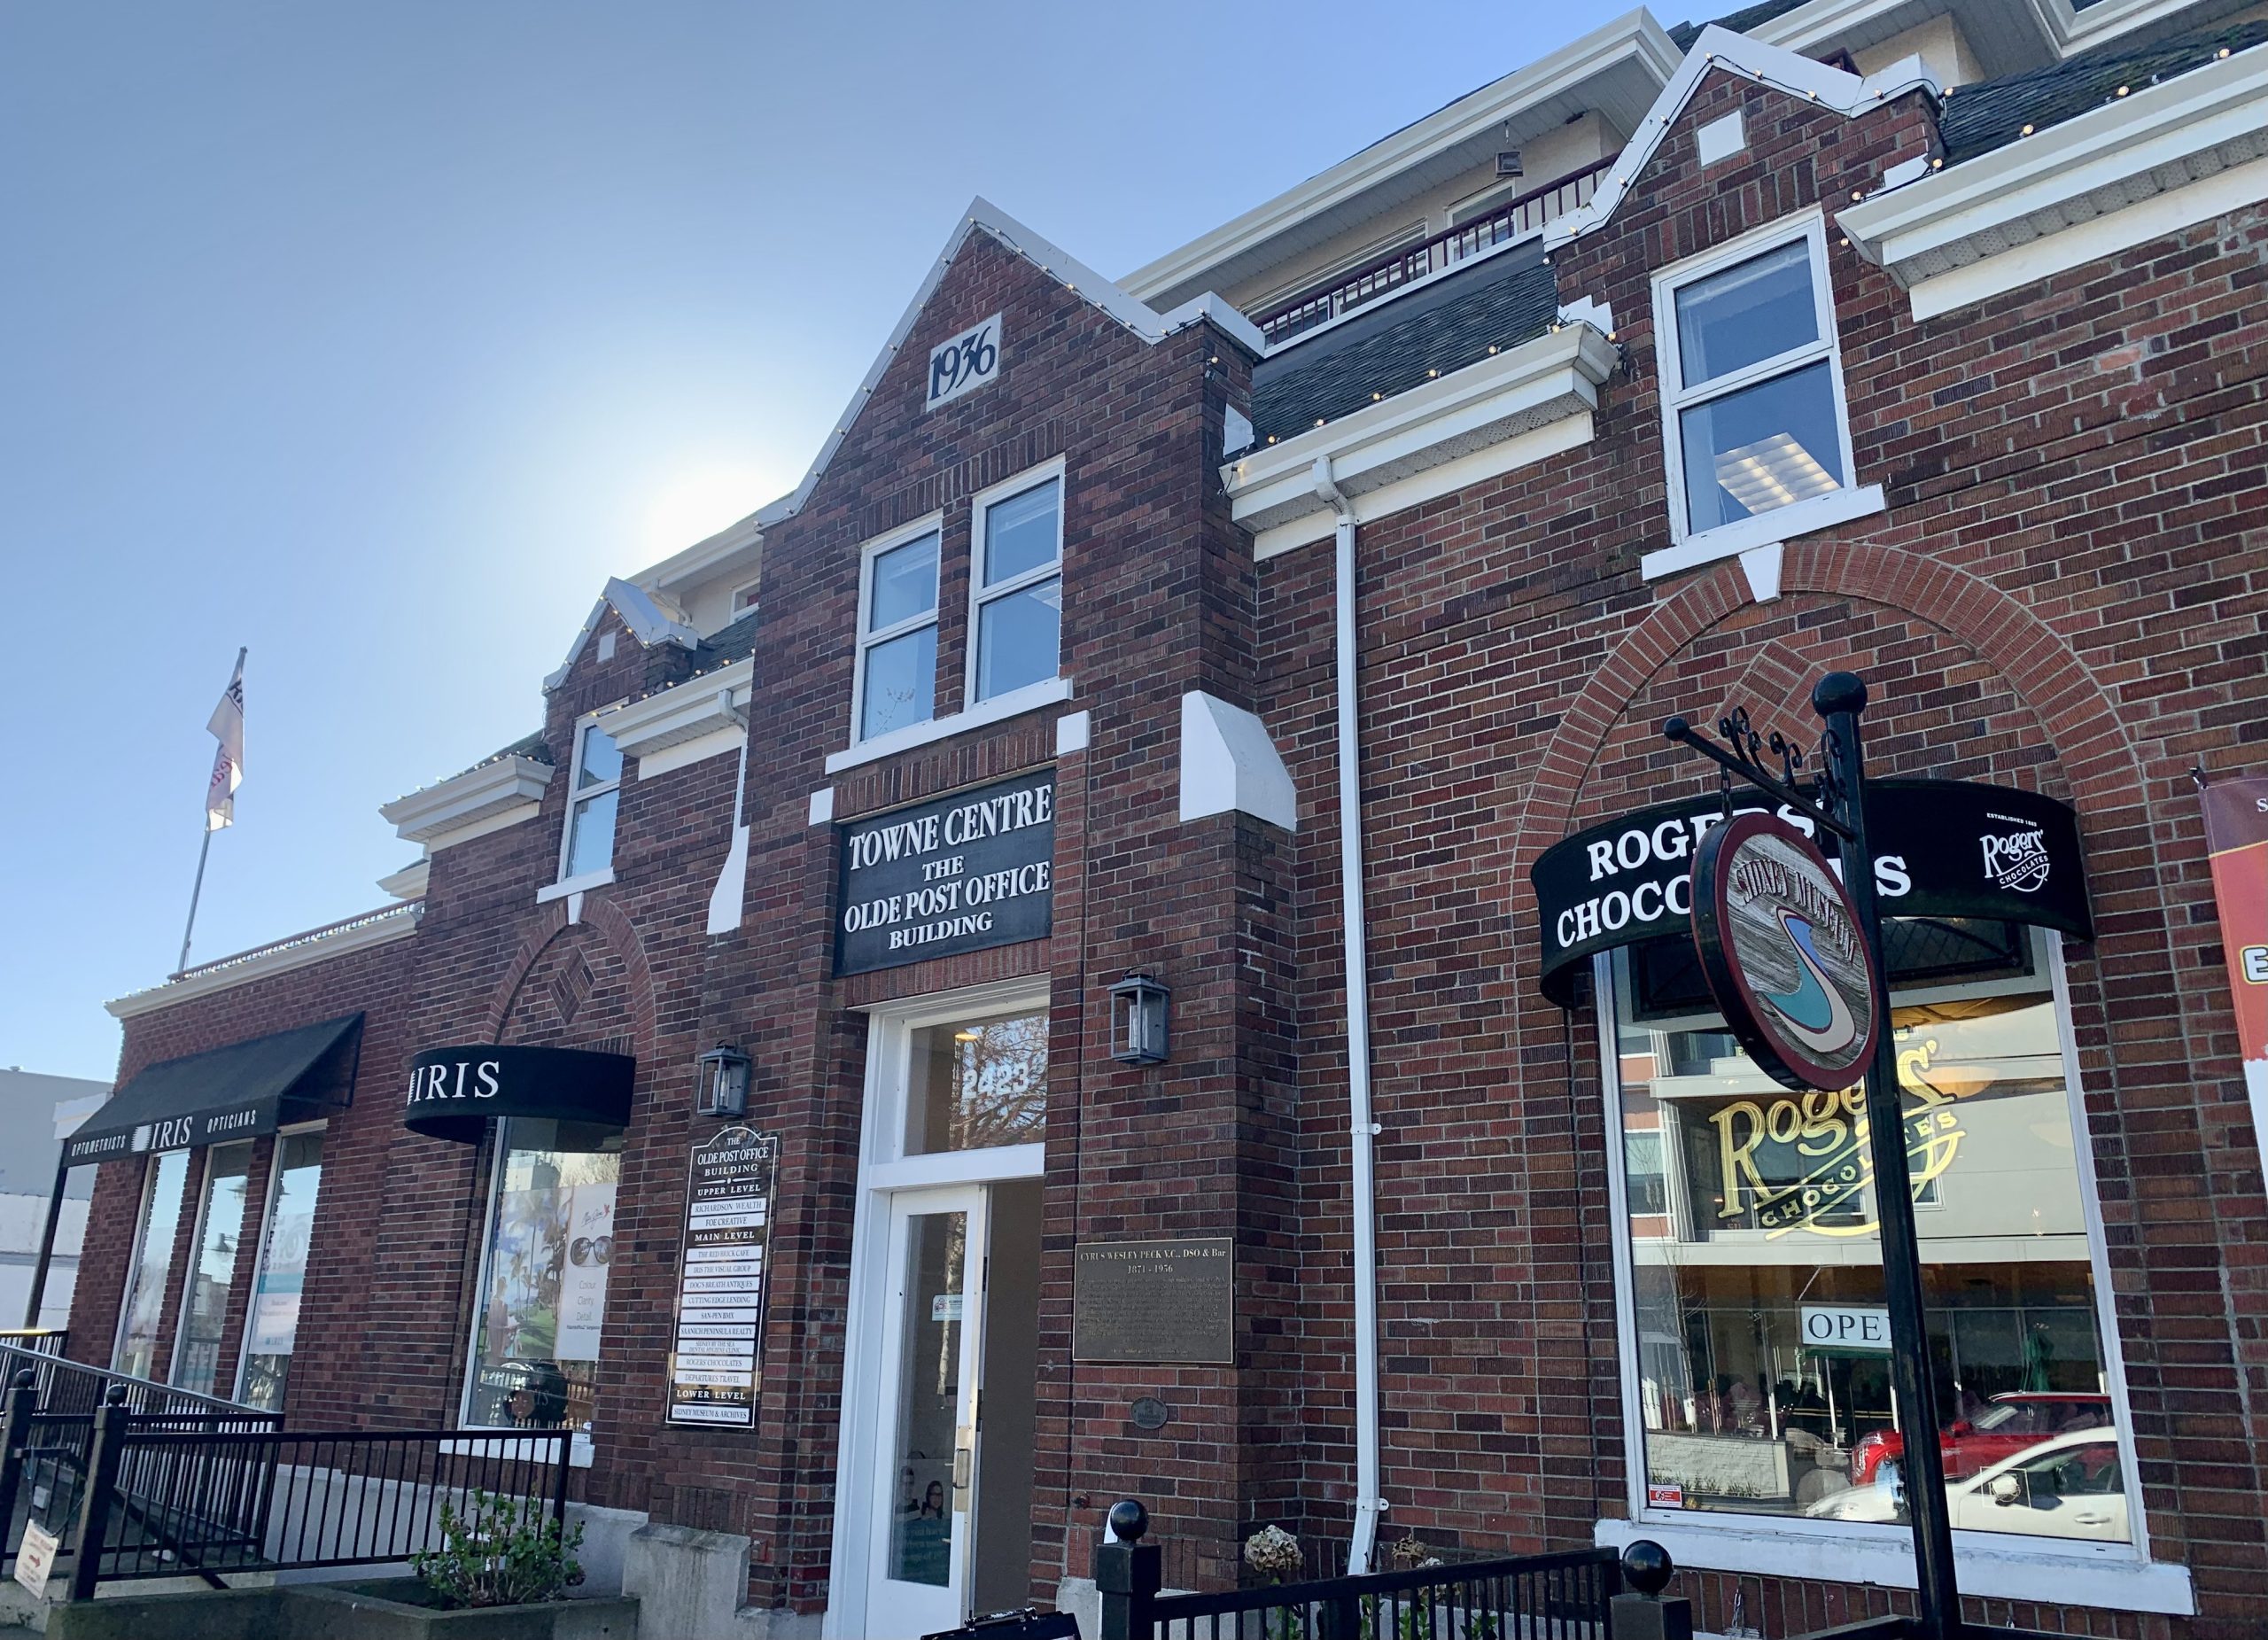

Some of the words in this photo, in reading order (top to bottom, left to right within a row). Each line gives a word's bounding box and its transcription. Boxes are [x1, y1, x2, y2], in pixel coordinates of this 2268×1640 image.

[928, 325, 996, 400] 1936
[850, 814, 940, 870] TOWNE
[944, 784, 1052, 846] CENTRE
[1986, 812, 2023, 824] ESTABLISHED
[922, 856, 964, 882] THE
[1999, 855, 2048, 884] CHOCOLATES
[844, 890, 902, 933] OLDE
[905, 880, 962, 920] POST
[965, 861, 1051, 906] OFFICE
[1557, 855, 1912, 948] CHOCOS
[1736, 859, 1788, 904] SIDNEY
[1795, 871, 1855, 964] MUSEUM
[889, 912, 994, 950] BUILDING
[414, 1061, 499, 1102] IRIS
[961, 1061, 1029, 1099] 2423
[71, 1134, 126, 1157] OPTOMETRISTS
[151, 1115, 193, 1150] IRIS
[206, 1109, 256, 1134] OPTICIANS
[727, 1137, 741, 1146] THE
[697, 1153, 718, 1165] OLDE
[718, 1149, 740, 1163] POST
[740, 1146, 769, 1161] OFFICE
[704, 1163, 758, 1177] BUILDING
[1760, 1110, 1958, 1228] CHOCOLES
[697, 1187, 726, 1196] UPPER
[731, 1184, 760, 1193] LEVEL
[695, 1203, 733, 1213] RICHARDSON
[735, 1201, 762, 1209] WEALTH
[718, 1216, 747, 1226] CREATIVE
[724, 1231, 755, 1240] LEVEL
[1107, 1251, 1138, 1260] WESLEY
[1140, 1250, 1162, 1259] PECK
[1183, 1249, 1200, 1258] DSO
[1211, 1248, 1226, 1257] Bar
[1127, 1265, 1146, 1274] 1871
[1808, 1313, 1892, 1341] OPE
[677, 1389, 710, 1398] LOWER
[714, 1391, 746, 1400] LEVEL
[720, 1411, 747, 1419] ARCHIVES
